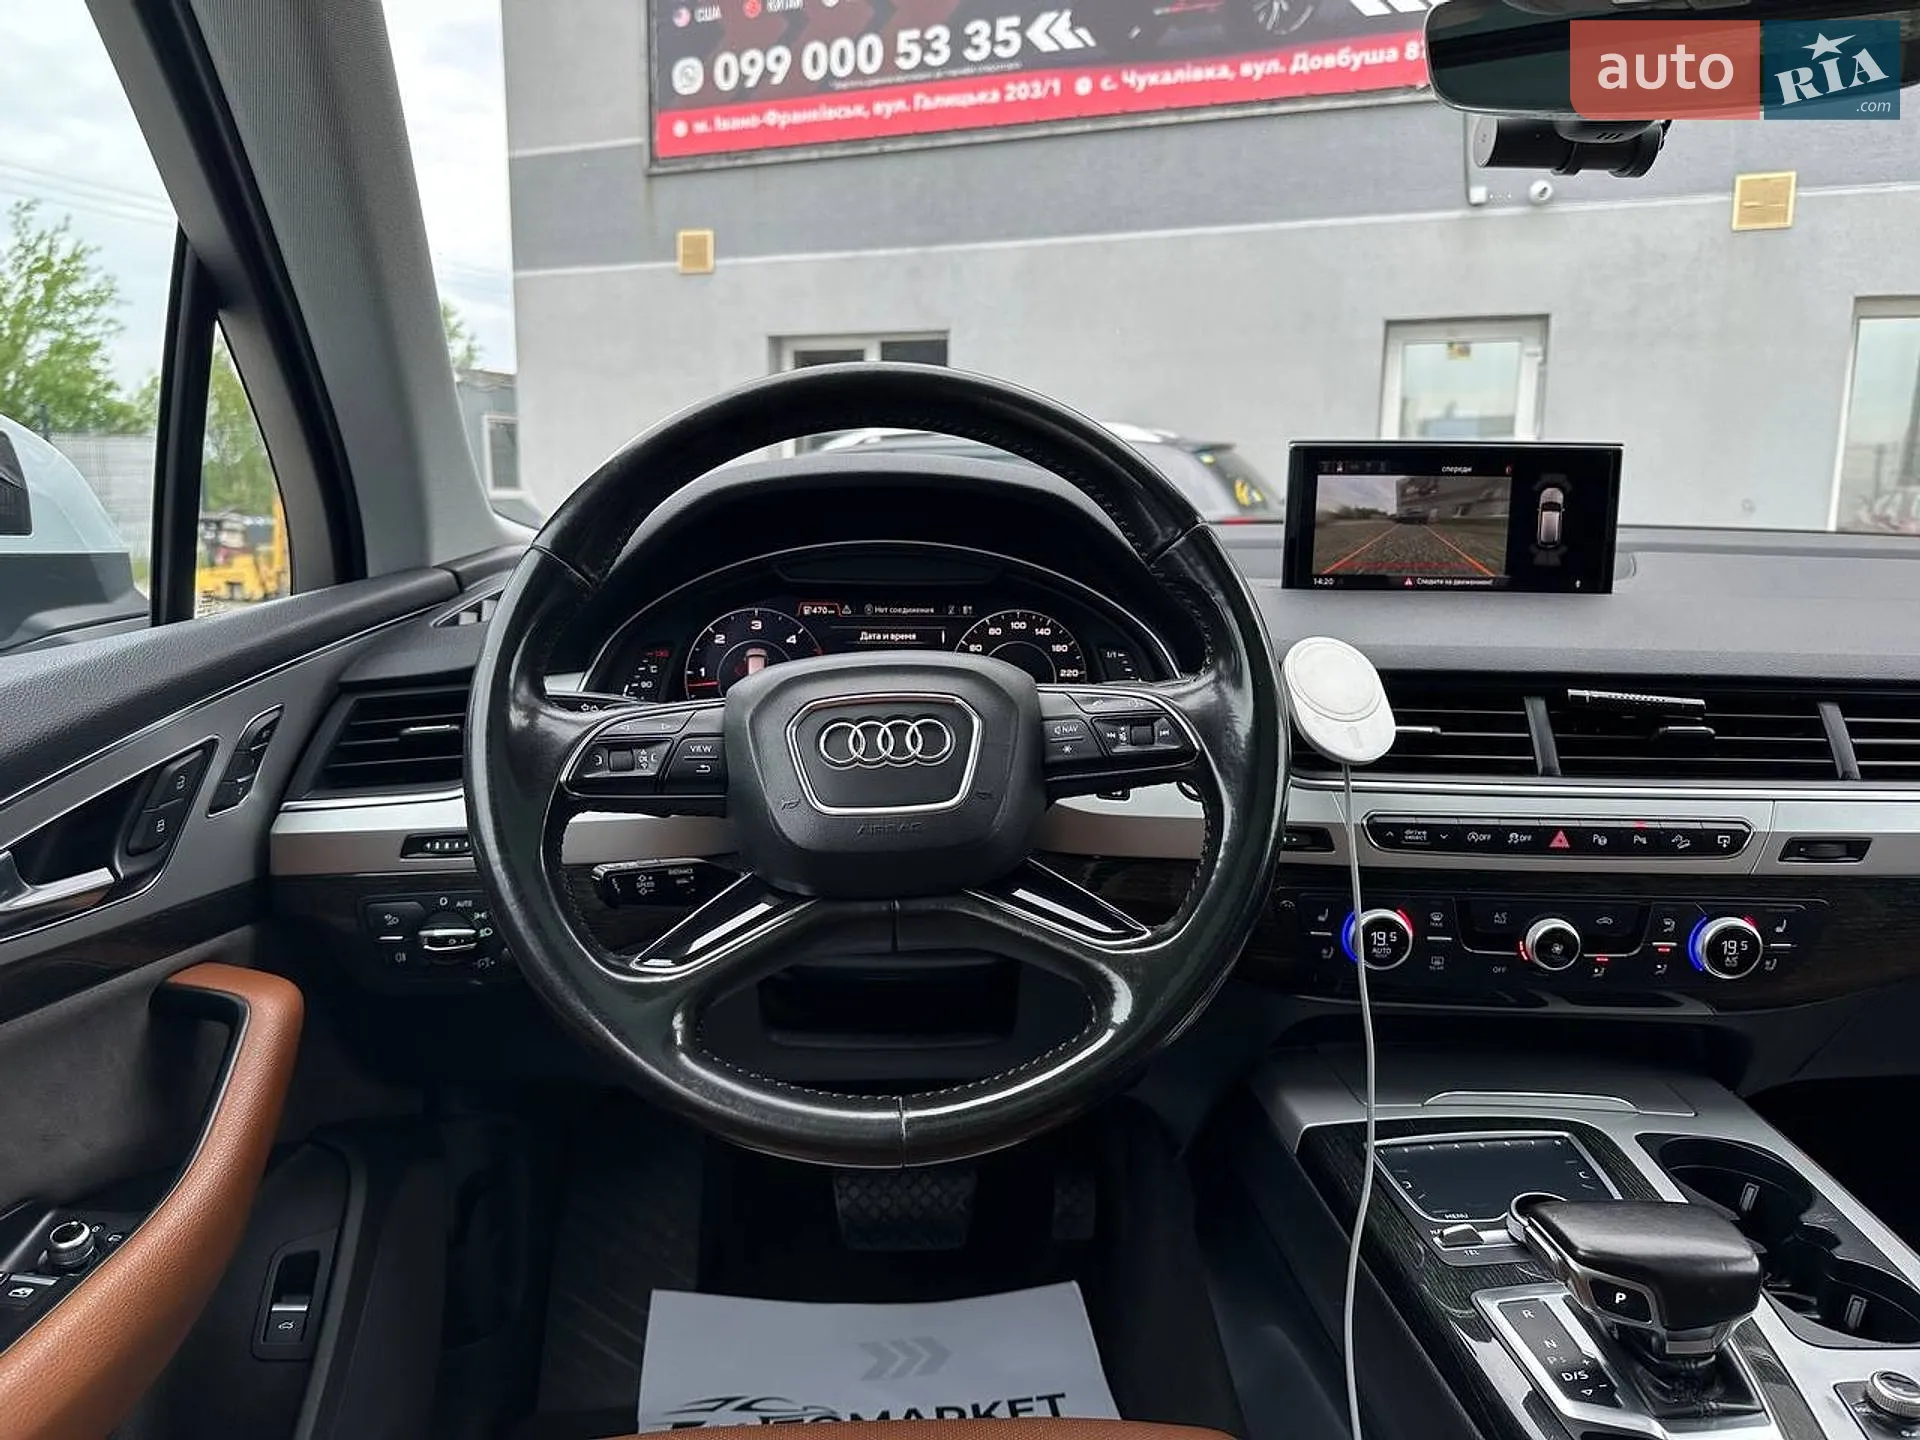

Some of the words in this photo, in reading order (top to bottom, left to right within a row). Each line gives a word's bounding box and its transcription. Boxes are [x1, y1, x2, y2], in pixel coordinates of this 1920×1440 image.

[713, 45, 792, 91] 099
[801, 34, 883, 81] 000
[895, 25, 951, 71] 53
[963, 16, 1022, 61] 35
[1121, 63, 1236, 92] Чукалівка,
[1239, 58, 1286, 81] вул.
[1289, 45, 1398, 75] Довбуша
[913, 88, 1000, 111] Галицька
[1004, 78, 1061, 102] 203/1
[812, 606, 827, 614] 470
[874, 605, 888, 614] Нет
[889, 605, 935, 615] соединения
[751, 620, 762, 630] 3
[1010, 621, 1027, 630] 100
[860, 631, 881, 641] Дата
[890, 633, 917, 642] время
[1035, 627, 1051, 636] 140
[714, 634, 726, 644] 2
[786, 634, 797, 644] 4
[699, 667, 706, 677] 1
[1059, 669, 1079, 677] 220
[1062, 725, 1078, 733] NAV
[690, 745, 712, 753] VIEW
[1479, 833, 1491, 842] OFF
[1519, 834, 1532, 843] OFF
[456, 900, 472, 908] AUTO
[1615, 1292, 1626, 1304] P
[1522, 1309, 1535, 1319] R
[1544, 1338, 1558, 1350] N
